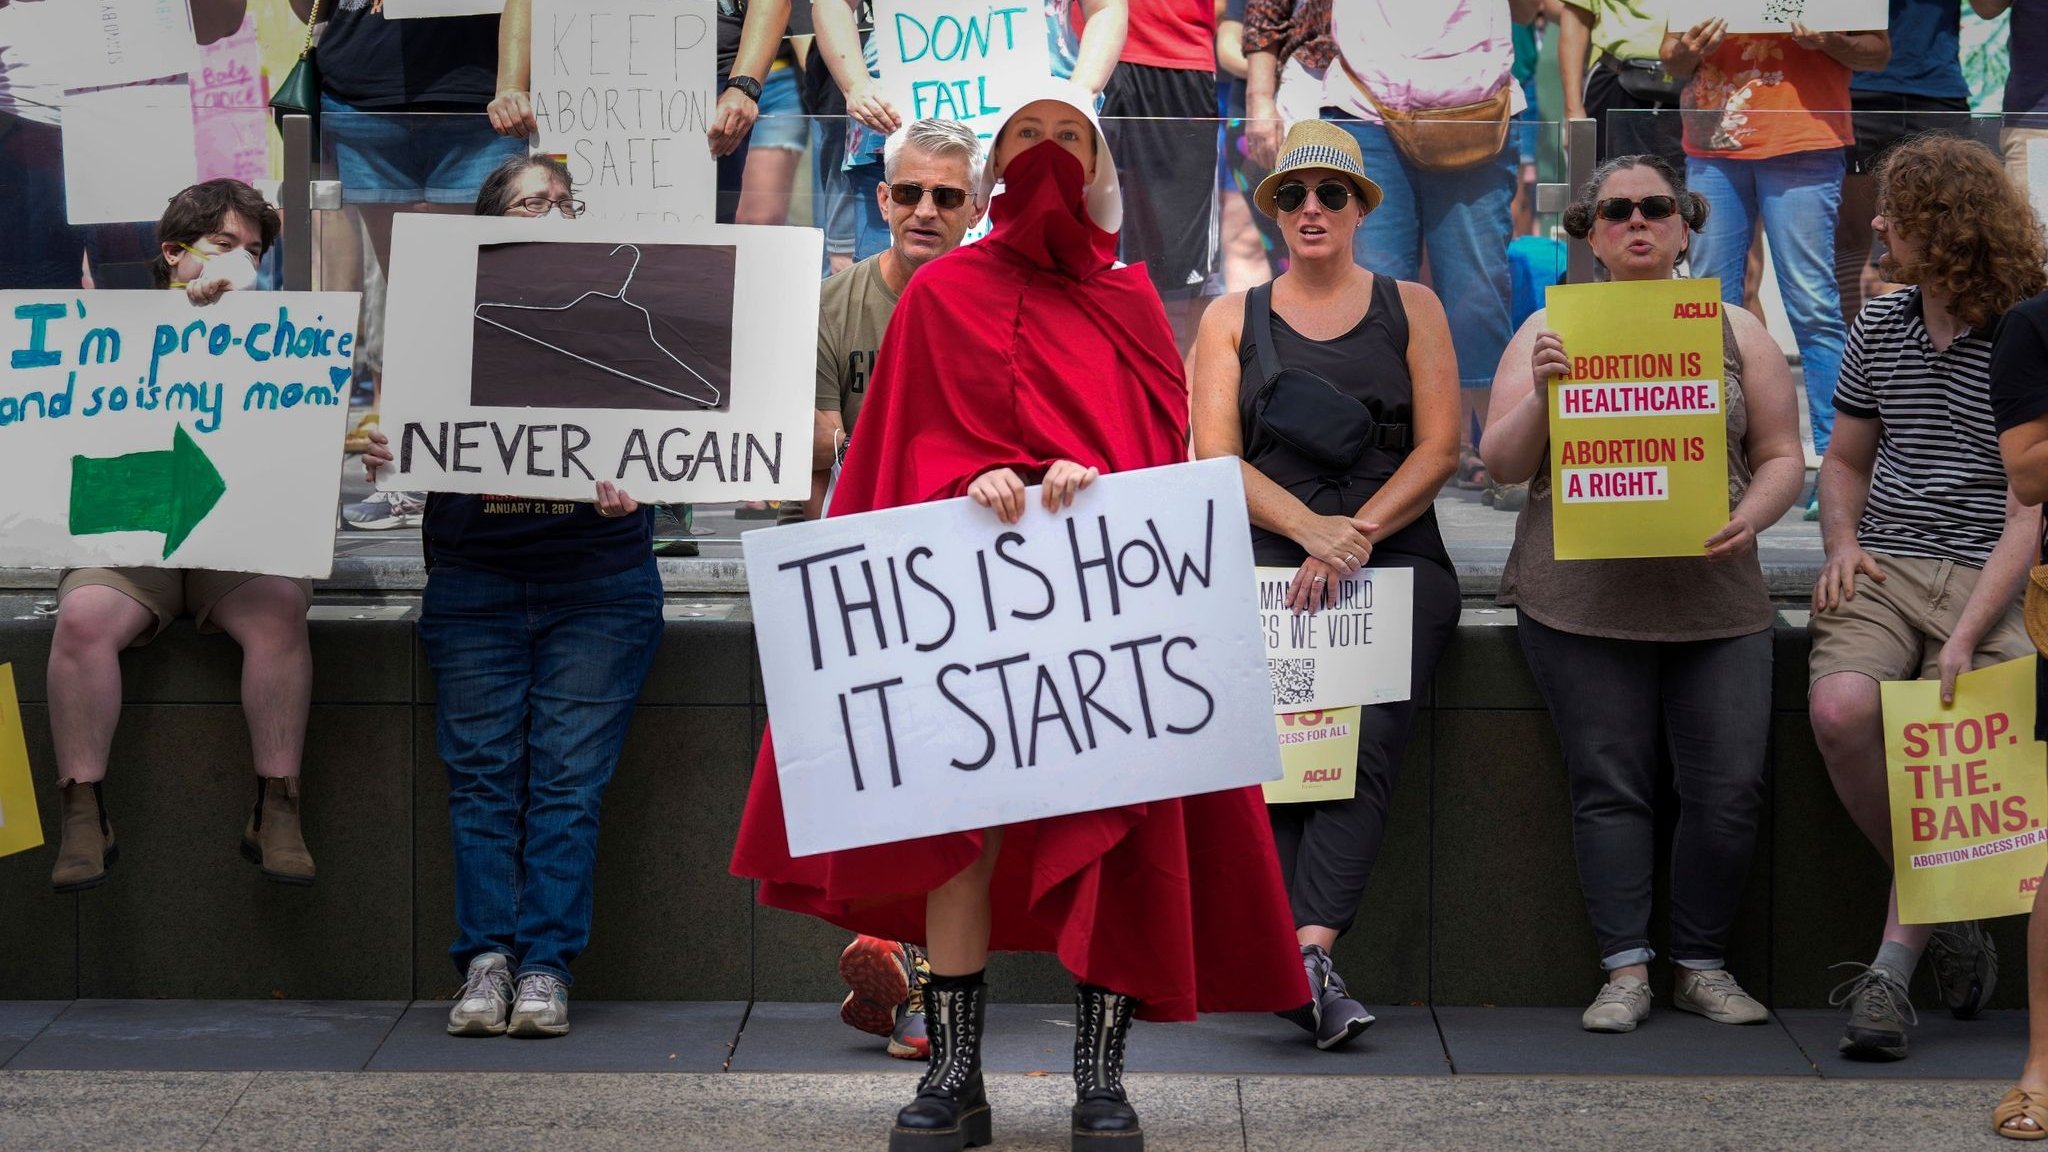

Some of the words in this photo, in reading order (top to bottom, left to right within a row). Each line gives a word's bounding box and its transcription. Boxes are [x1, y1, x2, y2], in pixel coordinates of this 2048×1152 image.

[553, 13, 707, 82] KEEP
[535, 86, 708, 134] ABORTION
[911, 75, 1002, 120] FAIL
[571, 138, 673, 189] SAFE
[1673, 302, 1718, 320] ACLU
[10, 298, 121, 369] I'm
[149, 306, 353, 388] pro-choice
[1680, 352, 1701, 377] IS
[0, 371, 77, 426] and
[1564, 384, 1717, 413] HEALTHCARE.
[400, 421, 595, 481] NEVER
[616, 427, 782, 484] AGAIN
[1561, 437, 1676, 465] ABORTION
[1683, 436, 1705, 461] IS
[1567, 474, 1583, 498] A
[1589, 471, 1664, 497] RIGHT.
[483, 502, 531, 514] JANUARY
[534, 503, 549, 515] 21,
[551, 503, 575, 515] 2017
[778, 543, 956, 671] THIS
[976, 531, 1055, 632] IS
[1290, 614, 1318, 649] WE
[1327, 612, 1373, 648] VOTE
[838, 677, 903, 791] IT
[936, 634, 1215, 771] STARTS
[1307, 728, 1327, 742] FOR
[1329, 724, 1348, 738] ALL
[1903, 711, 2018, 759] STOP.
[1302, 768, 1342, 783] ACLU
[1904, 758, 2001, 800] THE.
[1910, 795, 2039, 842] BANS.
[1913, 848, 1969, 868] ABORTION
[1972, 838, 2013, 859] ACCESS
[2015, 832, 2036, 849] FOR
